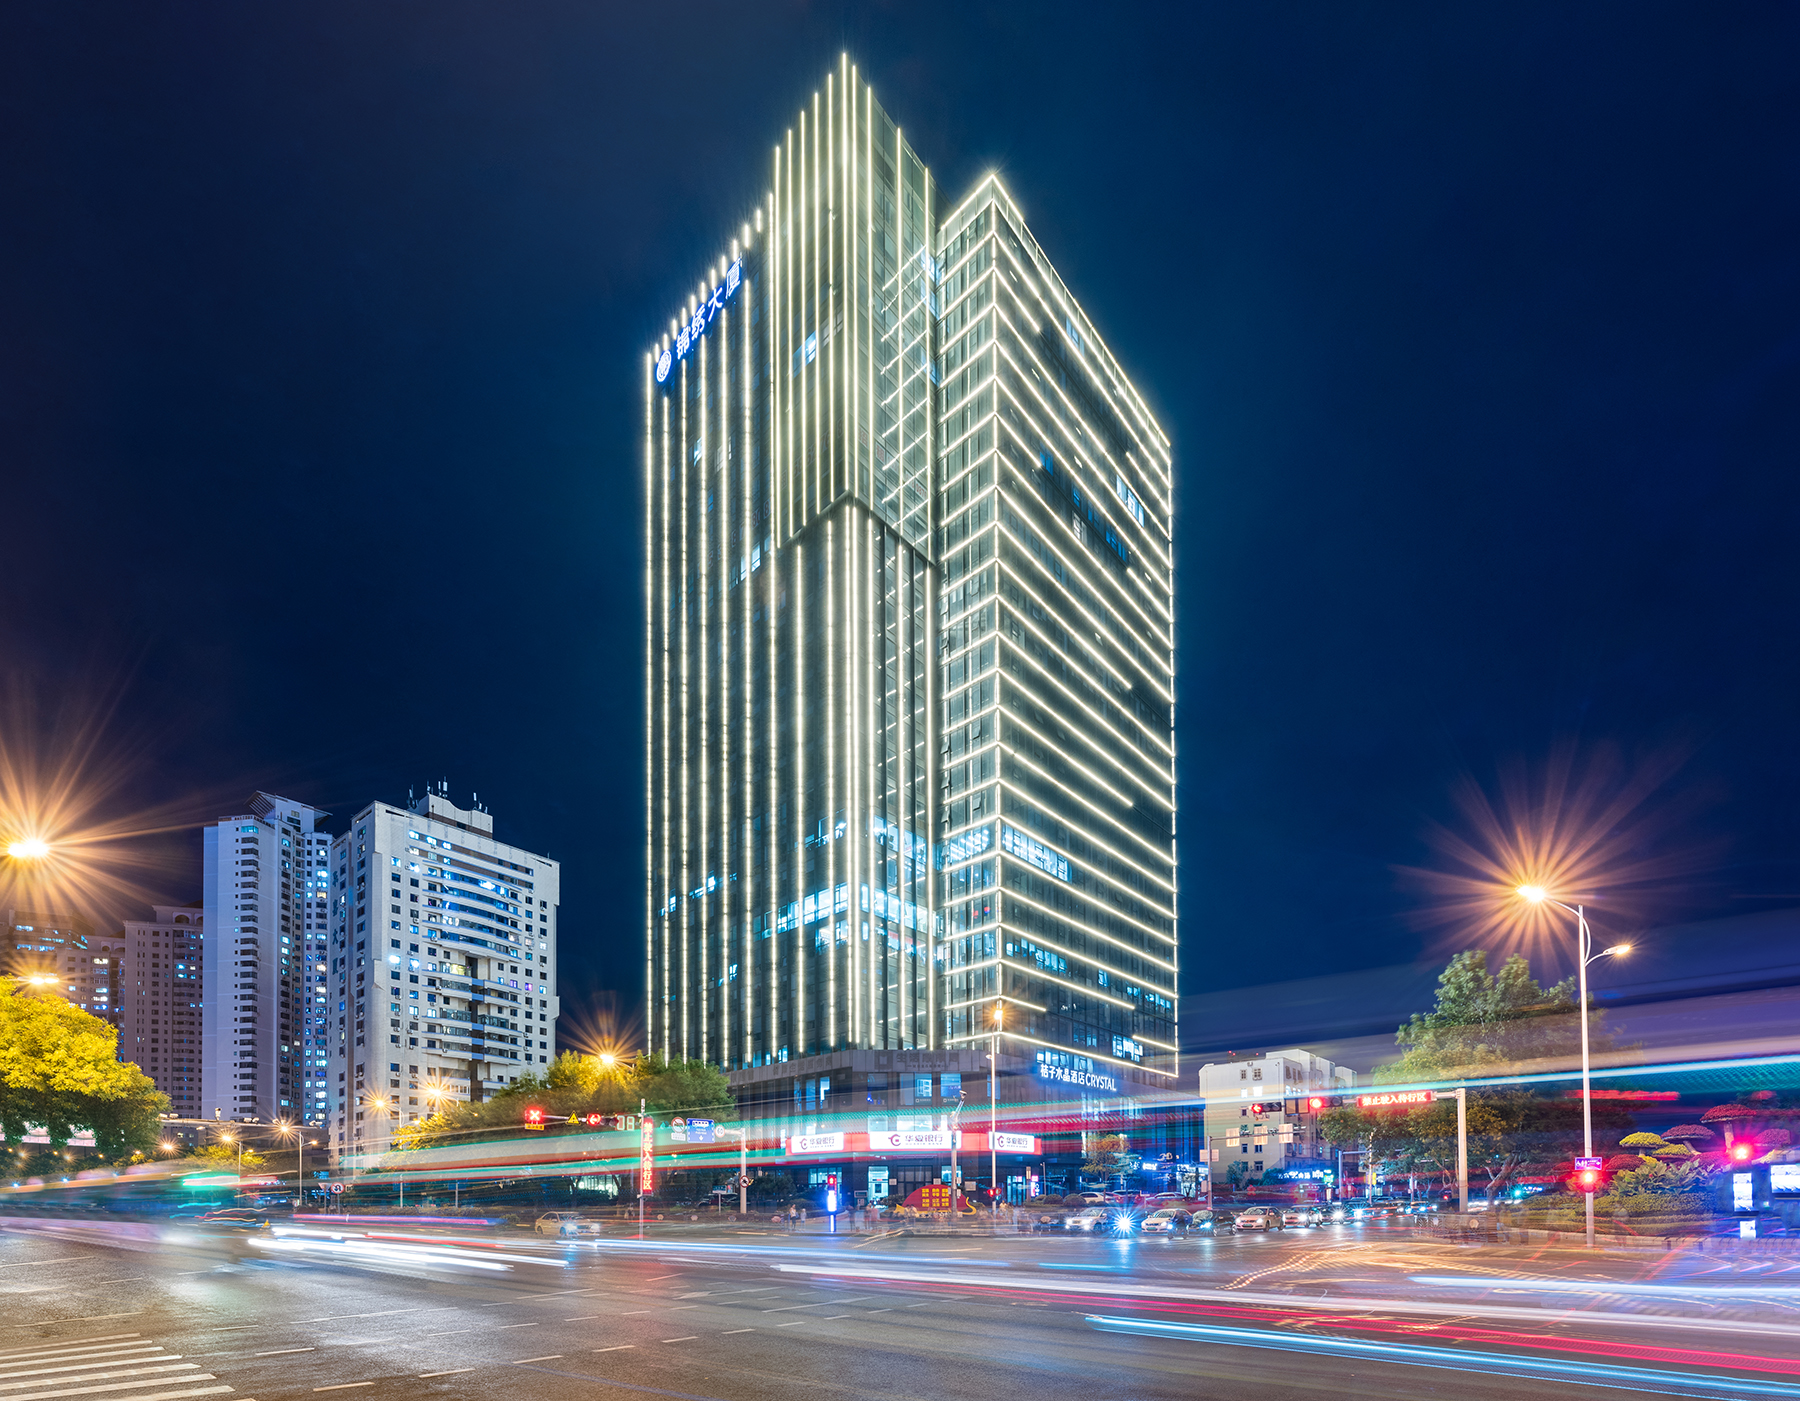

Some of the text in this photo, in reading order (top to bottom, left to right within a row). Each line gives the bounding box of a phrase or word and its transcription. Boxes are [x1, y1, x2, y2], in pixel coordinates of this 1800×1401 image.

[676, 257, 741, 360] 锦绣大厦
[1040, 1064, 1117, 1091] 桔子水晶酒店 CRYSTAL
[1362, 1092, 1427, 1106] 禁止驶入待行区
[905, 1134, 943, 1142] 华夏银行
[643, 1122, 653, 1190] 禁止驶入待行区
